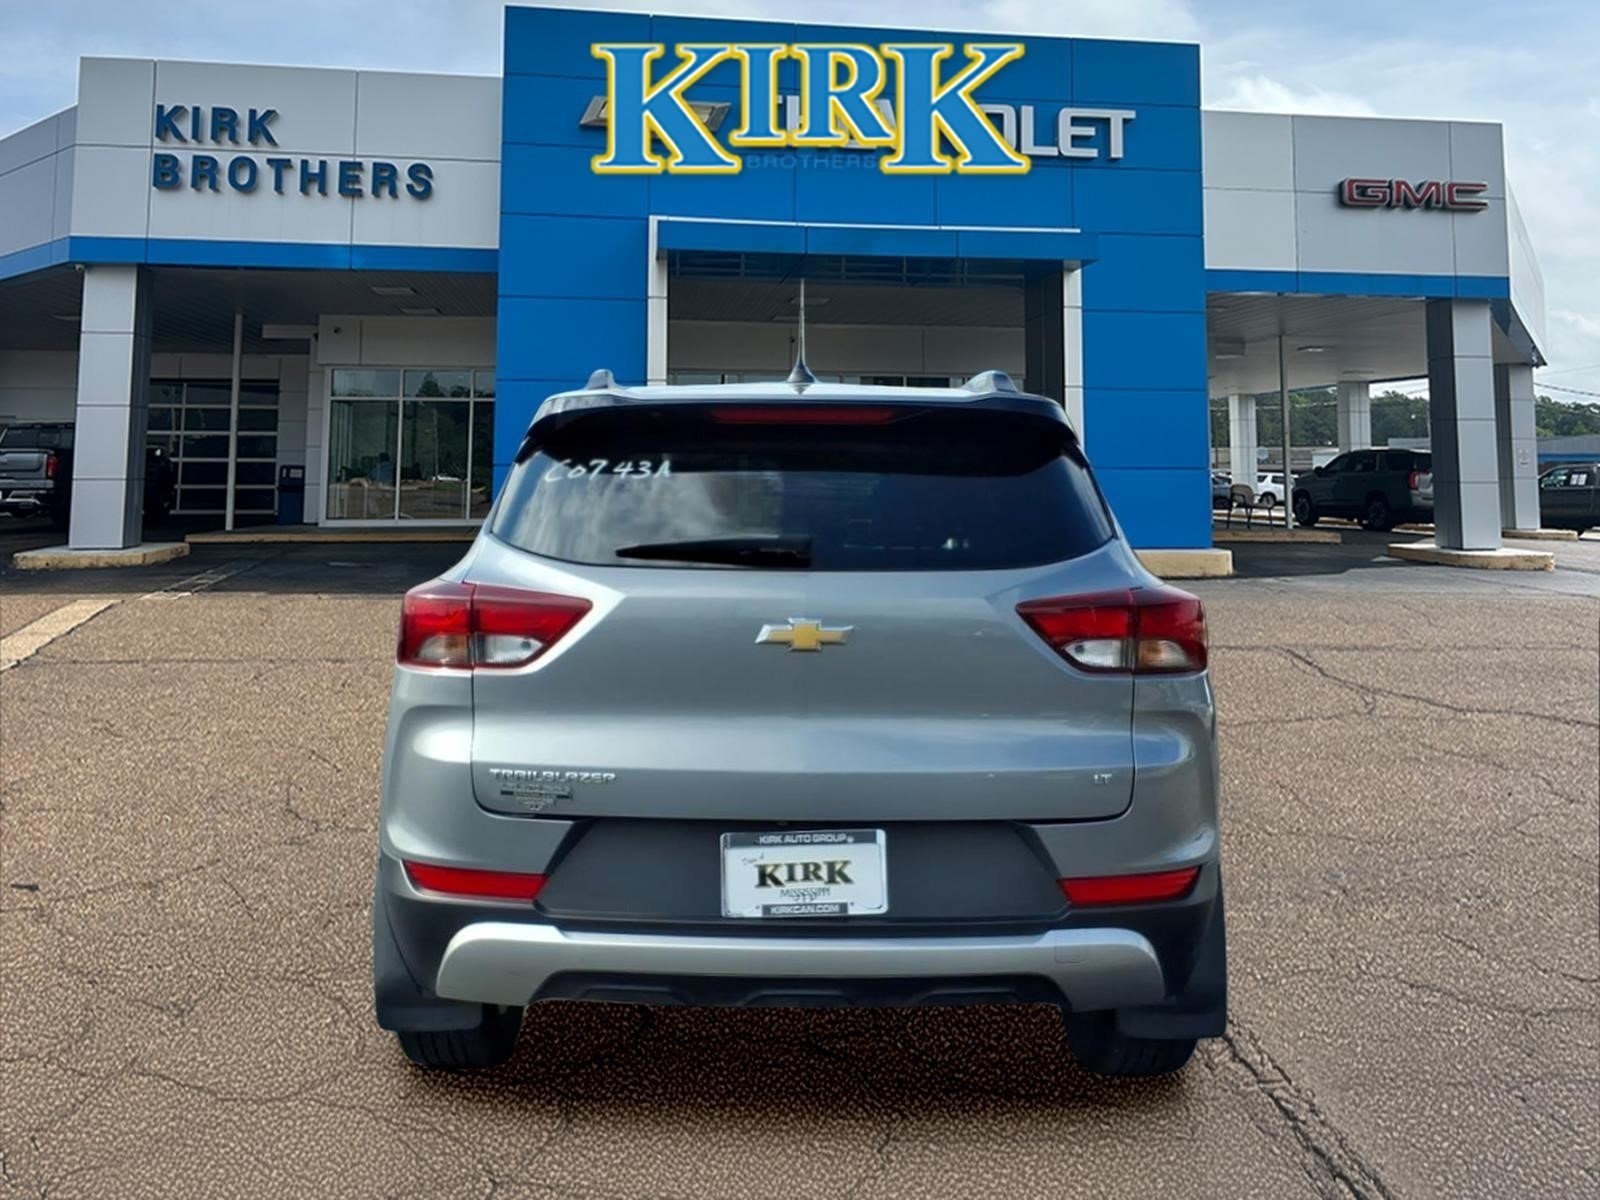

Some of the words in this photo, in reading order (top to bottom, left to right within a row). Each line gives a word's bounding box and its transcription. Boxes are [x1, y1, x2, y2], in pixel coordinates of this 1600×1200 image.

[155, 104, 280, 147] KIRK
[152, 153, 434, 200] BROTHERS
[1338, 177, 1489, 210] GMC
[489, 768, 617, 783] TRAILBLAZER
[1094, 773, 1113, 784] LT
[759, 835, 782, 845] KIRK
[783, 834, 811, 844] AUTO
[812, 832, 847, 843] GROUP
[755, 860, 854, 888] KIRK
